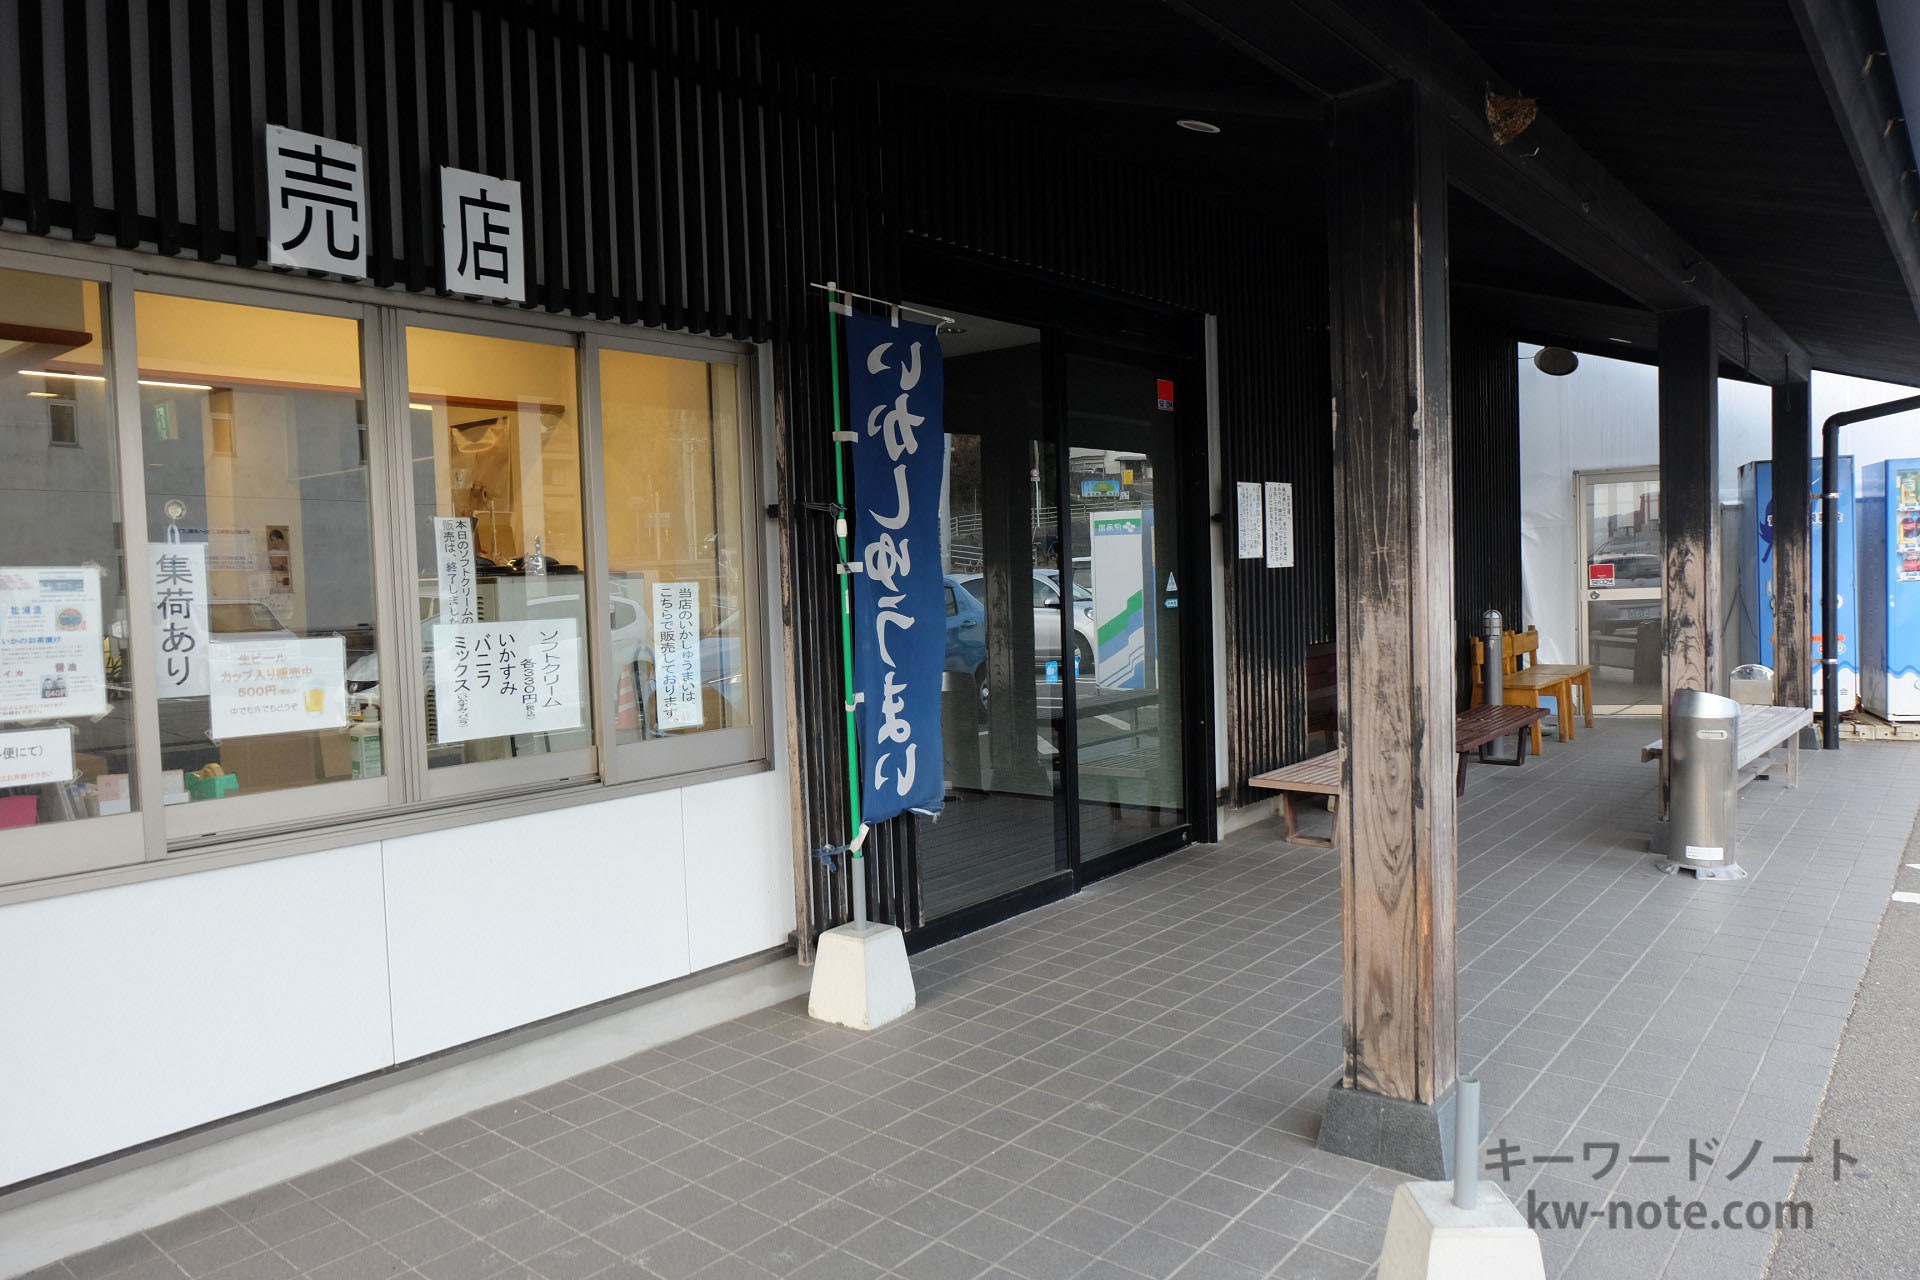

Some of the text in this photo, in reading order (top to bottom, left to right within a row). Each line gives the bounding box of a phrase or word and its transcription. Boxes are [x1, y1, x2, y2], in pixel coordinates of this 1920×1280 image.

[278, 144, 511, 284] 売店
[456, 520, 474, 624] 本日のソフトクリームの
[155, 554, 196, 686] 集荷あり
[660, 588, 680, 722] こちらで販売しております。
[454, 636, 471, 693] ミックス
[474, 633, 492, 689] バニラ
[499, 634, 518, 696] いかすみ
[520, 658, 538, 704] 各330円
[540, 630, 562, 708] ソフトクリーム
[0, 744, 43, 760] 便にて)
